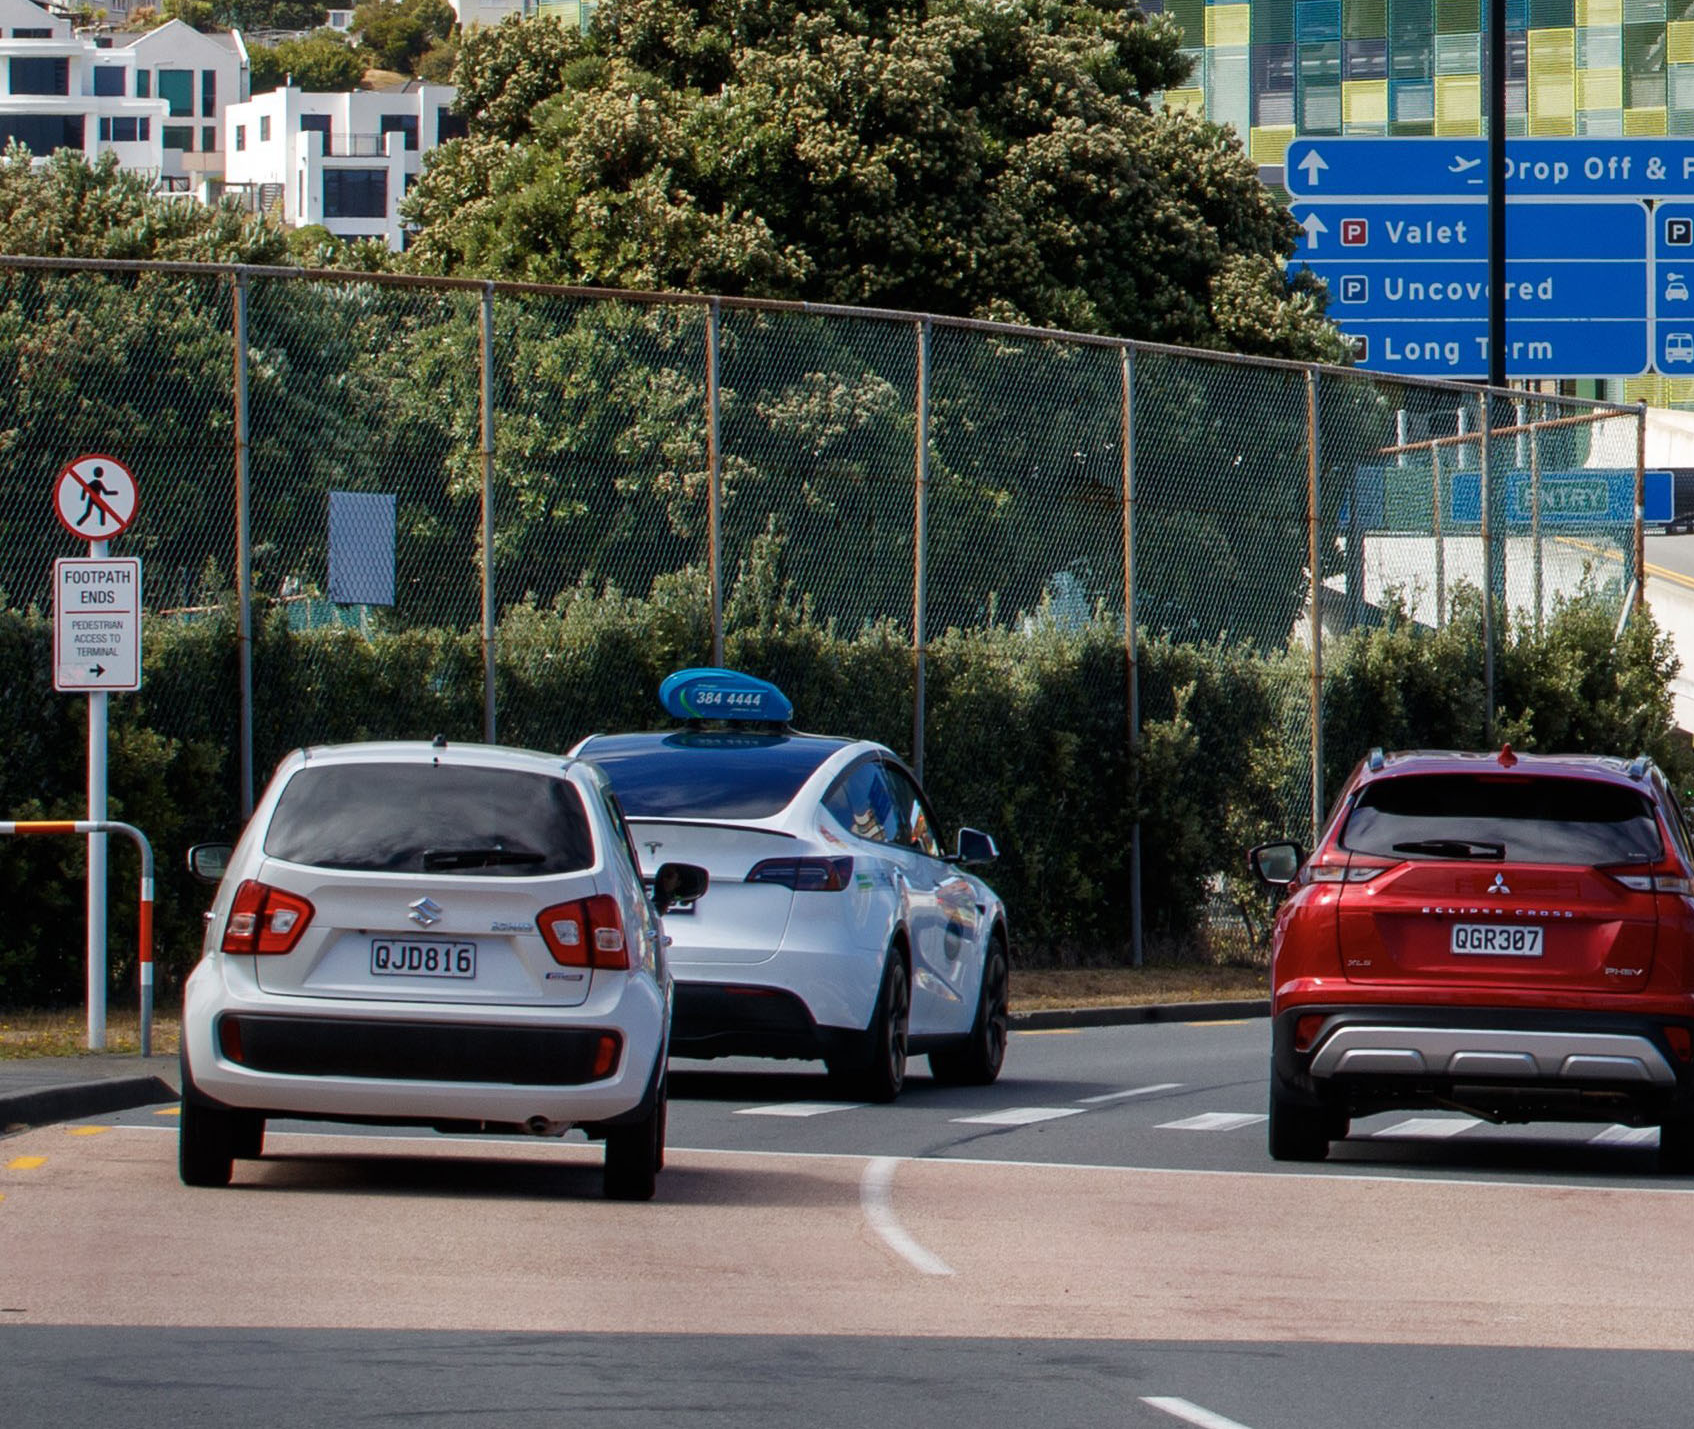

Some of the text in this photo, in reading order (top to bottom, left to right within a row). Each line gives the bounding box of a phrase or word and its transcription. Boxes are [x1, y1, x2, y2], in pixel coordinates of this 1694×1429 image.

[1584, 156, 1632, 180] Off
[1645, 156, 1667, 181] &
[1347, 220, 1468, 244] P Valet
[1672, 224, 1686, 240] P
[1347, 276, 1553, 301] P Uncovred
[1385, 336, 1553, 365] Long Trm
[64, 570, 131, 584] FOOTPATH
[81, 590, 115, 604] ENDS
[72, 620, 123, 630] PEDESTRIAN
[74, 634, 121, 644] ACCESS TO
[76, 647, 119, 657] TERMINAL
[696, 691, 761, 706] 384 4444
[1422, 906, 1573, 918] ECLIPSE CROSS
[1455, 928, 1540, 952] QGR307
[375, 945, 472, 972] QJD816
[1604, 967, 1643, 976] PHEV
